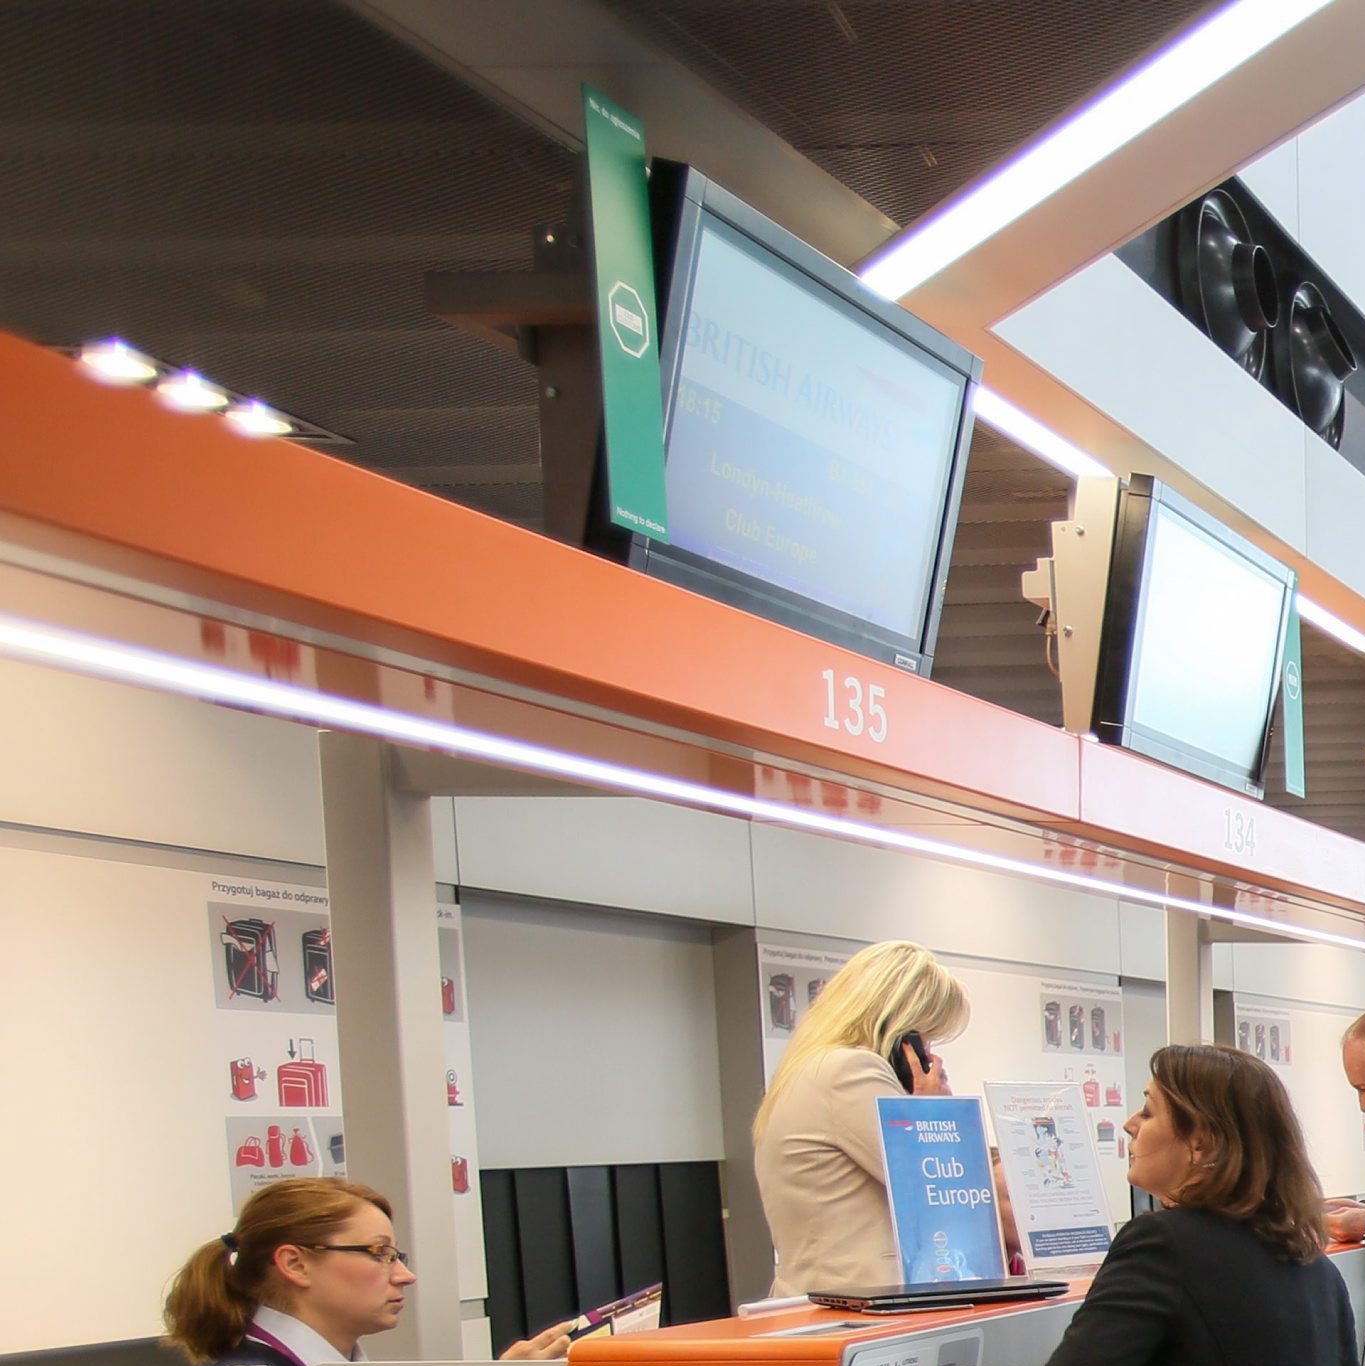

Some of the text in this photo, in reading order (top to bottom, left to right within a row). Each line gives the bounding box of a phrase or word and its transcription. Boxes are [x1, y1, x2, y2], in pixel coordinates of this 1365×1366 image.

[686, 311, 792, 397] BRITISH
[725, 508, 817, 564] Club Europe
[822, 669, 888, 743] 135
[1224, 807, 1256, 857] 134
[212, 881, 254, 898] Przygotuj
[282, 889, 294, 900] do
[916, 1121, 957, 1132] BRITISH
[918, 1132, 961, 1143] AIRWAYS
[921, 1157, 965, 1179] Club
[926, 1185, 992, 1209] Europe
